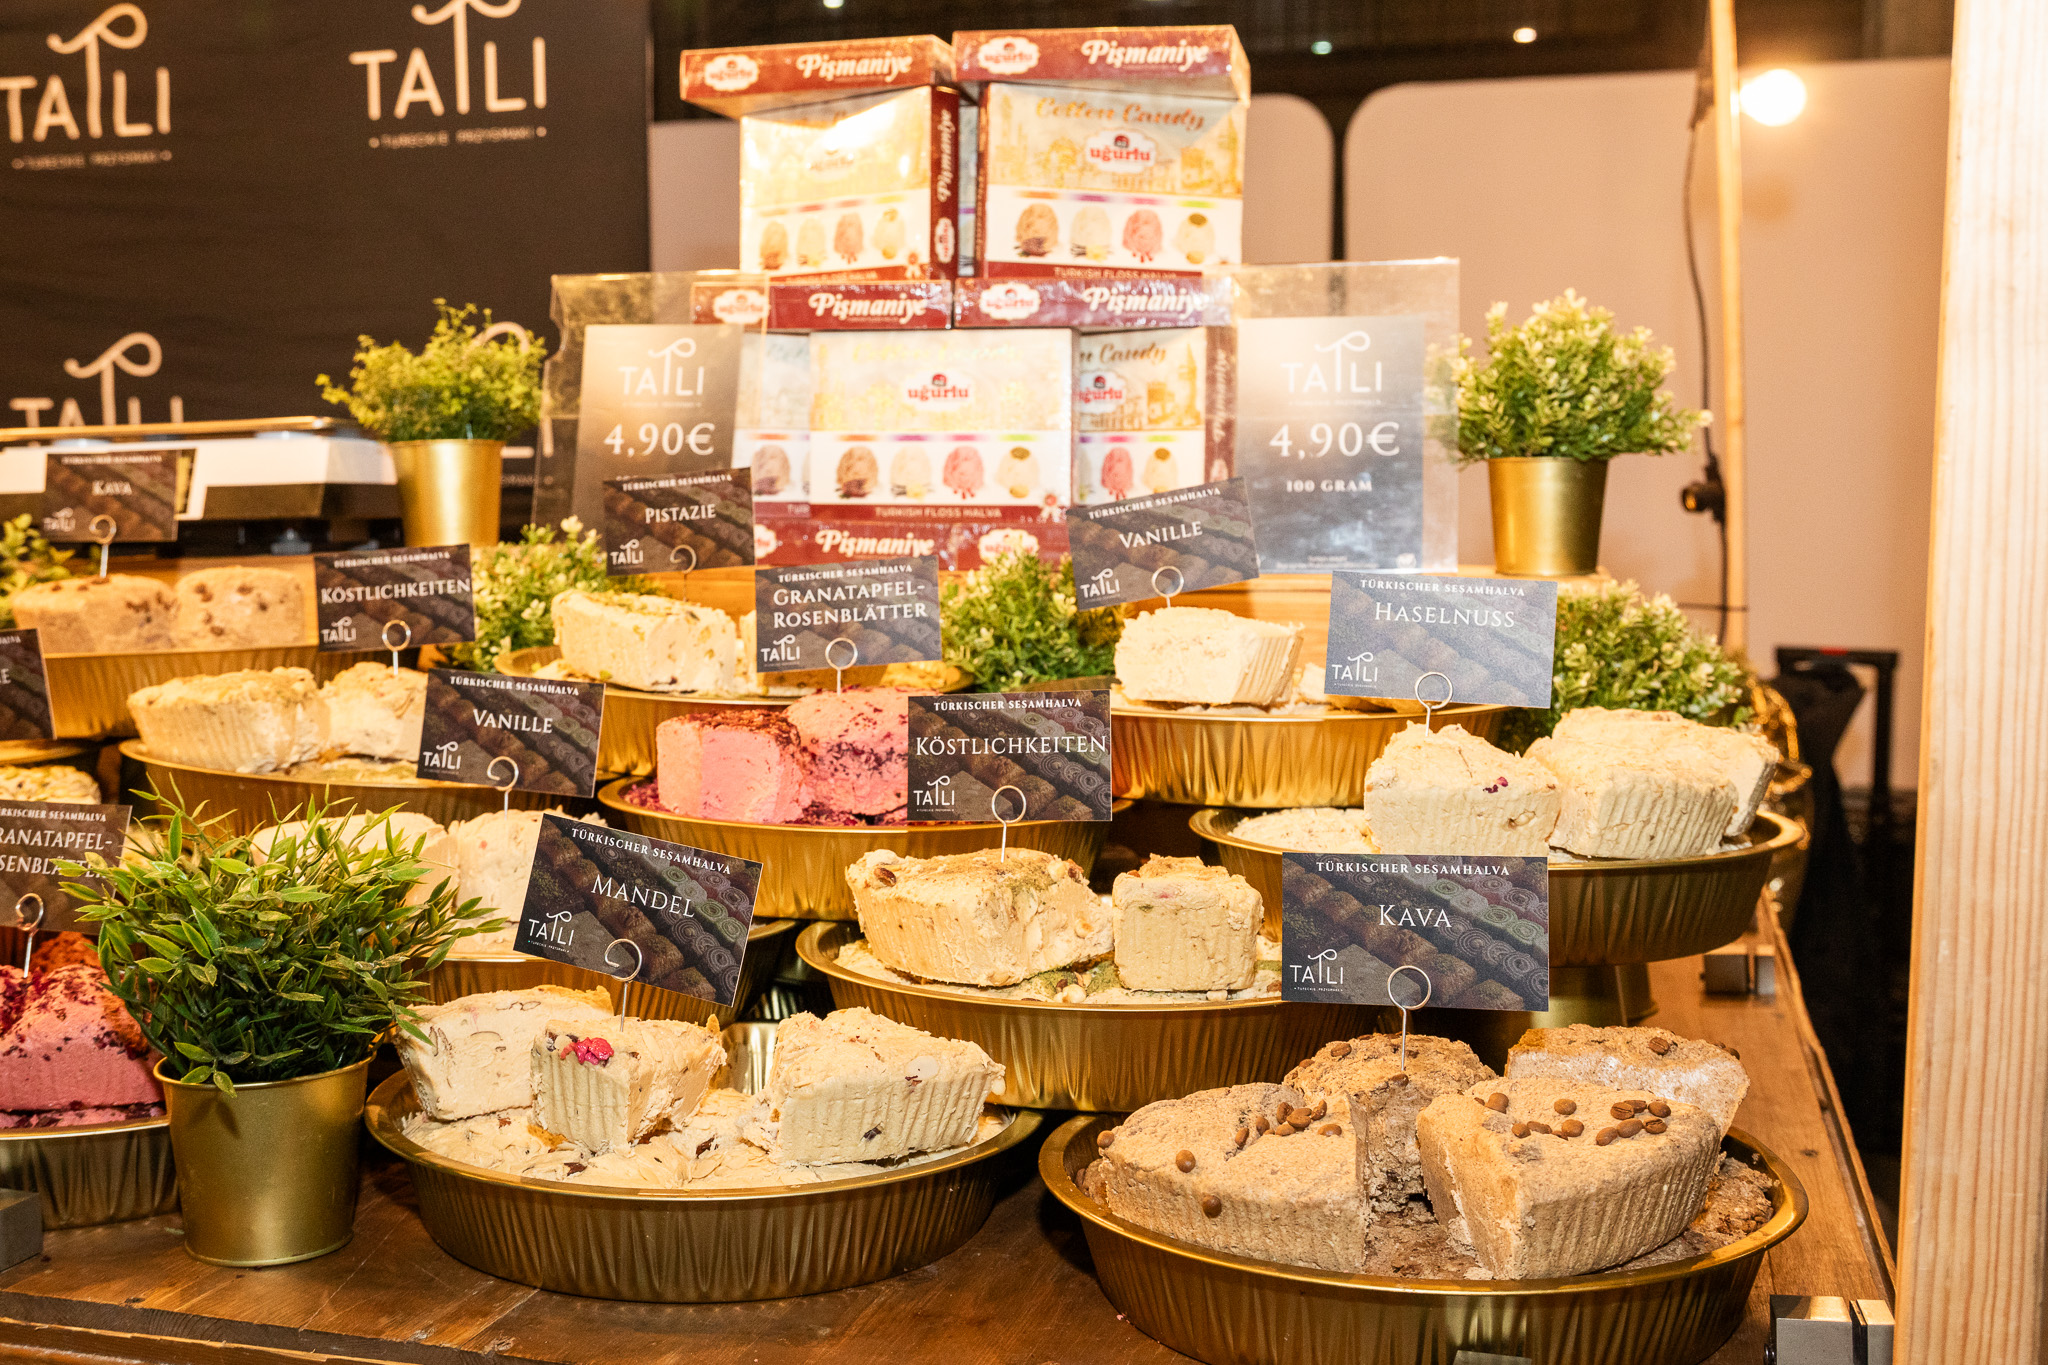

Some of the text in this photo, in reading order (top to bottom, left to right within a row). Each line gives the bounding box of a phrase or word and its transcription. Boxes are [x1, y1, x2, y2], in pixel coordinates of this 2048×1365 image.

[348, 0, 546, 121] TATLI
[796, 51, 914, 82] Pişmaniye
[1081, 38, 1209, 72] Pişmaniye
[0, 3, 171, 143] TATLI
[808, 292, 928, 324] Pişmaniye
[1082, 287, 1210, 320] Pişmaniye
[617, 337, 705, 397] TATLI
[1280, 331, 1383, 393] TATLI
[907, 384, 970, 402] uğurlu
[604, 422, 716, 458] 4,90€
[1269, 421, 1401, 460] 4,90€
[1286, 480, 1373, 492] 100 GRAM
[645, 504, 717, 524] PISTAZIE
[1088, 487, 1221, 520] TÜRKISCHER SESAMHALVA
[1118, 520, 1204, 549] VANILLE
[610, 538, 644, 565] TATLI
[778, 564, 912, 584] TÜRKISCHER SESAMHALVA
[1080, 568, 1120, 599] TATLI
[1360, 578, 1525, 597] TÜRKISCHER SESAMHALVA
[321, 578, 471, 605] KÖSTLICHKEITEN
[773, 581, 926, 606] GRANATAPFEL-
[773, 602, 929, 629] ROSENBLÄTTER
[1374, 601, 1515, 628] HASELNUSS
[760, 634, 800, 662] TATLI
[1331, 651, 1378, 683] TATLI
[449, 676, 580, 696] TÜRKISCHER SESAMHALVA
[933, 698, 1082, 711] TÜRKISCHER SESAMHALVA
[472, 708, 554, 734] VANILLE
[422, 740, 461, 770] TATLI
[916, 735, 1107, 756] KÖSTLICHKEITEN
[913, 775, 955, 806] TATLI
[48, 810, 107, 822] SESAMHALVA
[571, 827, 732, 875] TÜRKISCHER SESAMHALVA
[1316, 860, 1510, 876] TÜRKISCHER SESAMHALVA
[590, 874, 696, 918] MANDEL
[528, 910, 575, 946] TATLI
[1378, 904, 1453, 929] KAVA
[1289, 948, 1344, 985] TATLI
